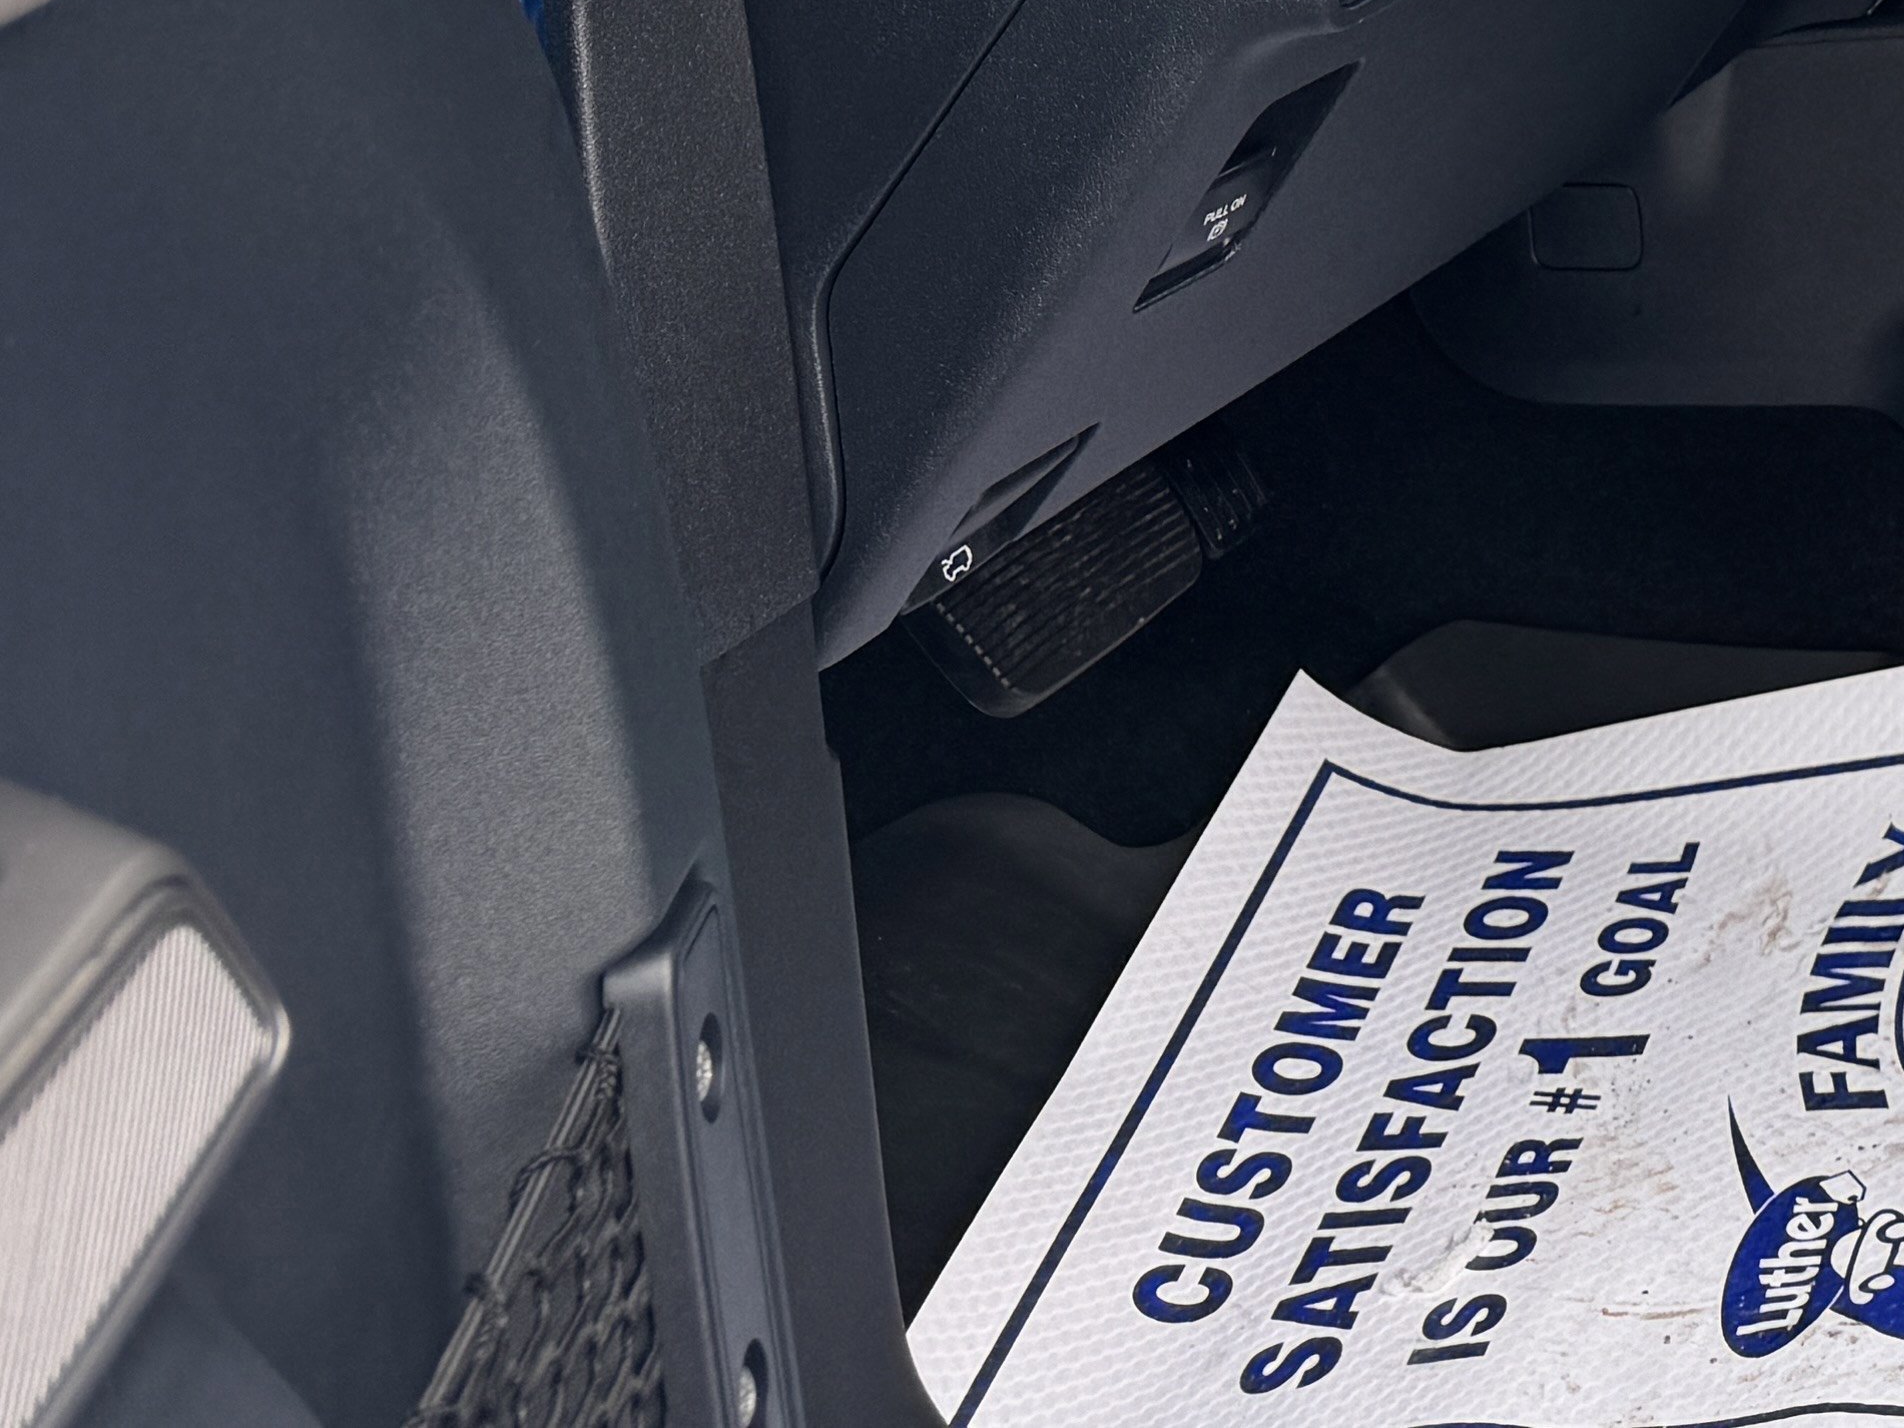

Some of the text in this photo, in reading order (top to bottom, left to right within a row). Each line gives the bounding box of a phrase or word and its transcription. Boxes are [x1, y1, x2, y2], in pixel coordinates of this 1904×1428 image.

[1203, 193, 1248, 225] PULL ON
[1132, 887, 1426, 1324] CUSTOMER
[1239, 849, 1576, 1395] SATISFACTION
[1406, 841, 1701, 1365] IS OUR #1 GOAL
[1735, 1177, 1840, 1340] Luther
